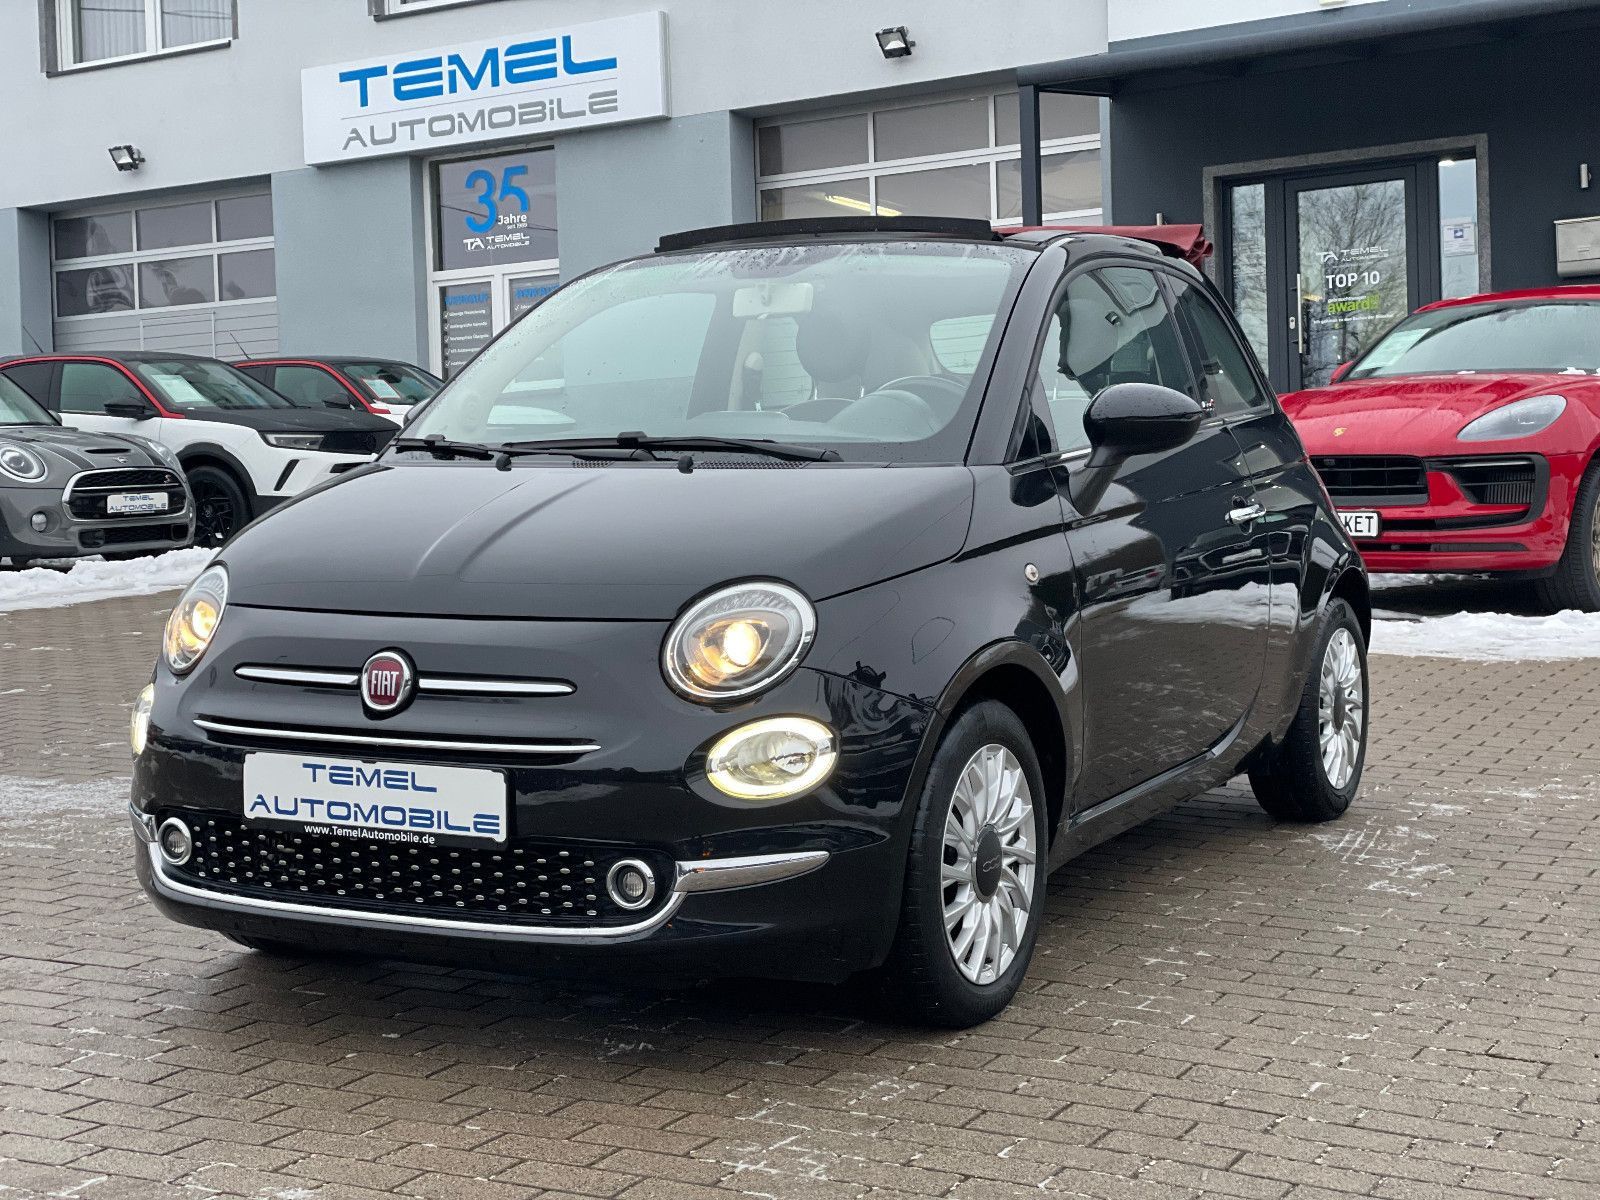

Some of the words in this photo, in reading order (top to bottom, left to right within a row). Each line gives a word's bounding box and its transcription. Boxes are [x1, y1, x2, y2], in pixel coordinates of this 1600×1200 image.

[339, 35, 617, 107] TEMEL
[465, 165, 529, 234] 35
[498, 213, 527, 225] Jahre
[486, 232, 530, 243] TEMEL
[1340, 246, 1389, 256] TEMEL
[1326, 272, 1358, 289] TOP
[1361, 270, 1380, 285] 10
[370, 669, 400, 697] FIAT
[302, 762, 437, 793] TEMEL
[249, 794, 500, 835] AUTOMOBILE
[304, 825, 436, 845] www.TemelAutomobile.de
